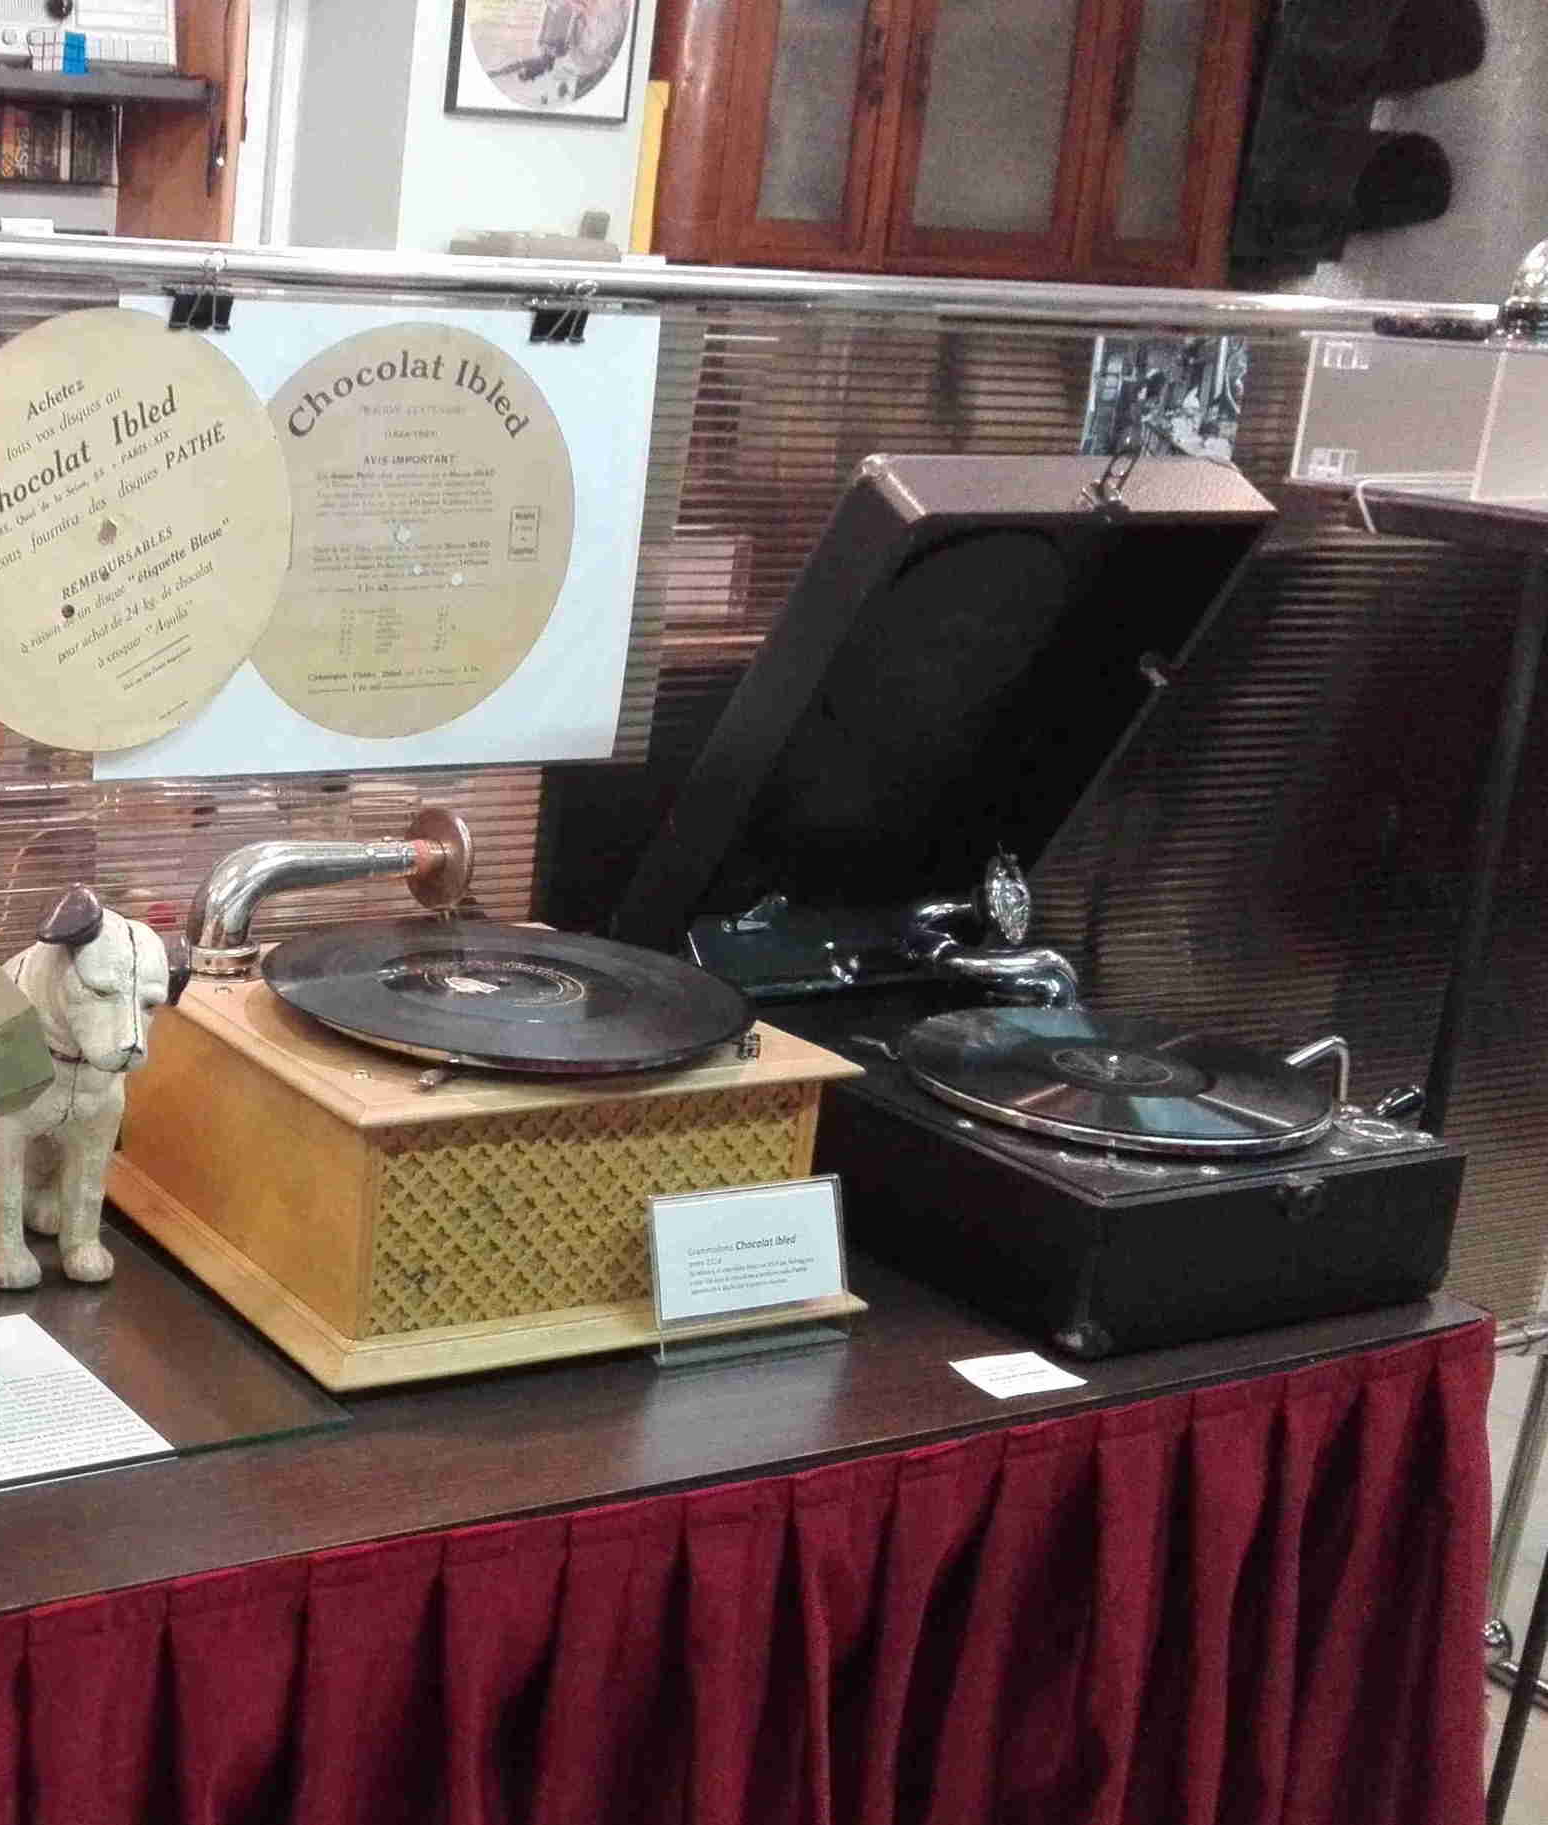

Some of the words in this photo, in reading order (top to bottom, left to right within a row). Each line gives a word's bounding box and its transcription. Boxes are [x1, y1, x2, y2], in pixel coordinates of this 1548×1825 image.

[27, 379, 85, 421] Achetez
[112, 383, 177, 446] Ibled
[287, 351, 445, 438] Chocolat
[455, 359, 531, 439] Ibled
[31, 514, 80, 554] fournira
[88, 497, 108, 516] des
[165, 420, 227, 470] PATHÉ
[392, 454, 456, 465] IMPORTANT
[61, 525, 173, 601] REMBOURSABLES
